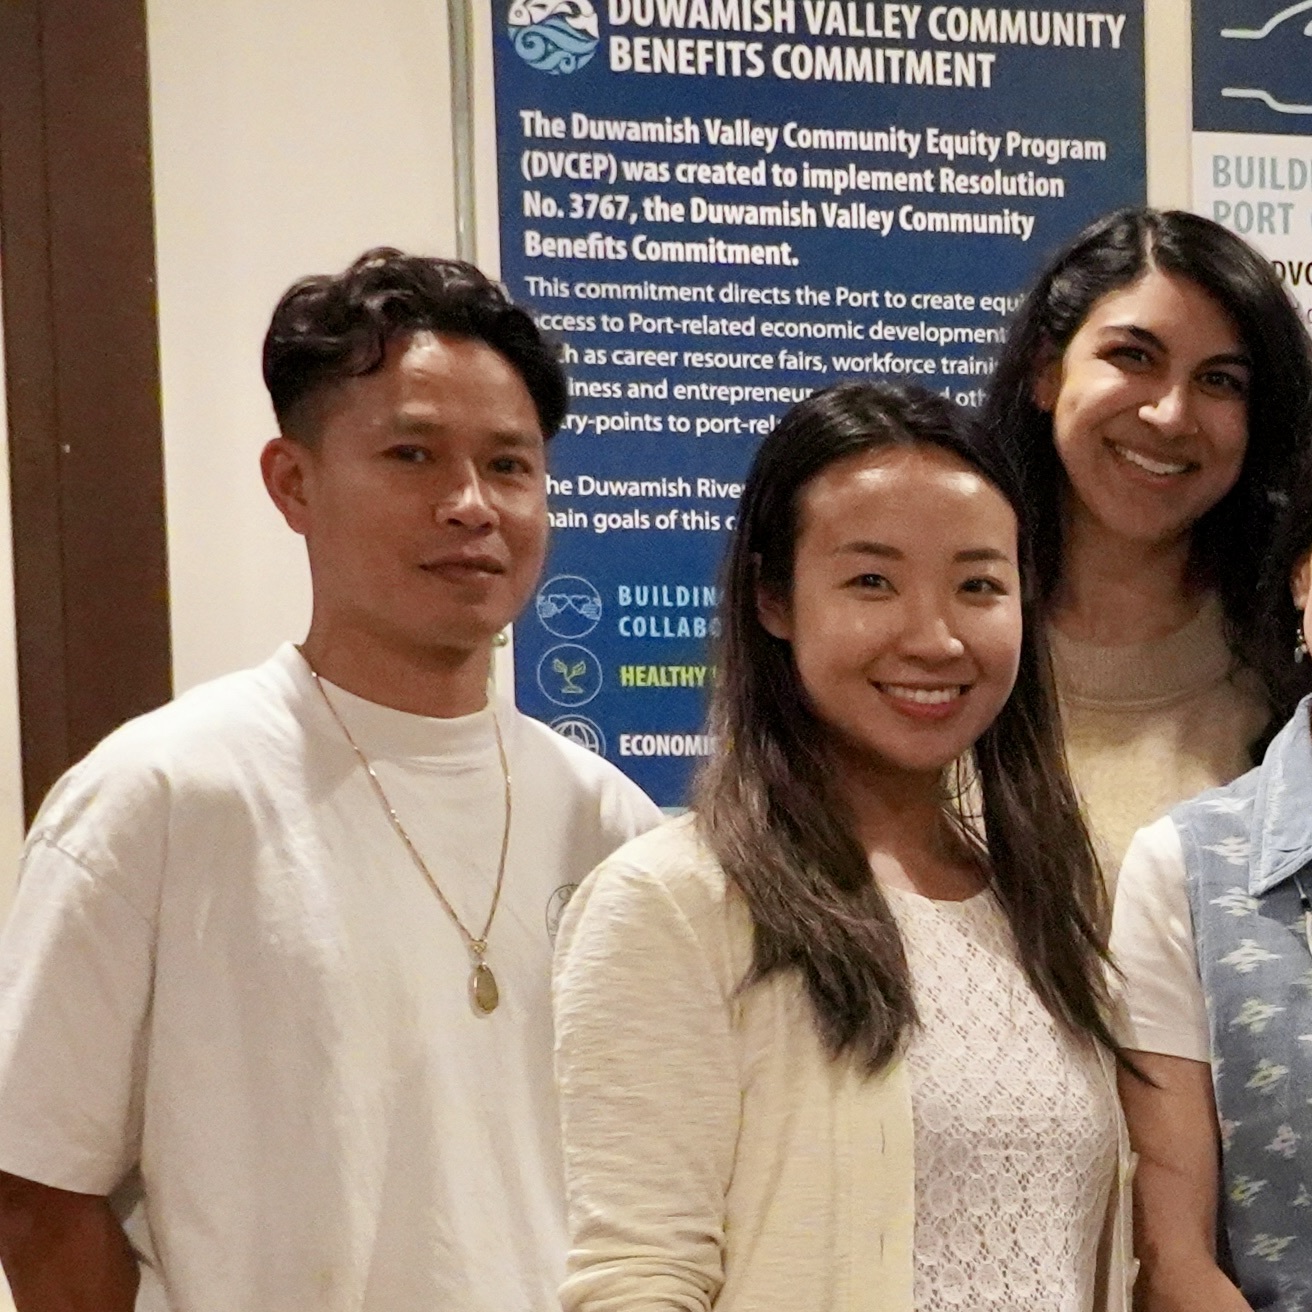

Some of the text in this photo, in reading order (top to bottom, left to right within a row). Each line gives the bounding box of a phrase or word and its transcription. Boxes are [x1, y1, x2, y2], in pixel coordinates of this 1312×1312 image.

[608, 0, 1126, 48] DUWAMISH VALLEY COMMUNITY
[610, 36, 995, 87] BENEFITS COMMITMENT
[520, 110, 1106, 164] The Duwamish Valley Community Equity Program
[521, 150, 1064, 197] (DVCEP) was created to implement Resolution
[524, 191, 1034, 241] No. 3767, the Duwamish Valley Community
[1213, 200, 1294, 235] PORT
[525, 230, 799, 266] Benefits Commitment.
[524, 276, 569, 297] This
[574, 281, 714, 302] commitment
[719, 282, 791, 304] directs
[795, 286, 830, 306] the
[836, 287, 879, 307] Port
[884, 291, 906, 308] to
[911, 294, 975, 310] create
[601, 315, 624, 332] to
[629, 313, 755, 336] Port-related
[761, 320, 864, 339] economic
[584, 349, 606, 364] as
[612, 350, 678, 366] career
[684, 352, 773, 369] resource
[778, 350, 827, 373] fairs,
[832, 352, 936, 373] workforce
[569, 378, 622, 399] iness
[627, 379, 667, 399] and
[560, 411, 782, 436] ry-points to port-rel
[546, 474, 572, 496] he
[578, 476, 691, 497] Duwamish
[593, 509, 650, 533] goals
[655, 509, 678, 529] of
[682, 510, 720, 530] this
[618, 585, 719, 607] BUILDIN
[621, 666, 706, 687] HEALTHY
